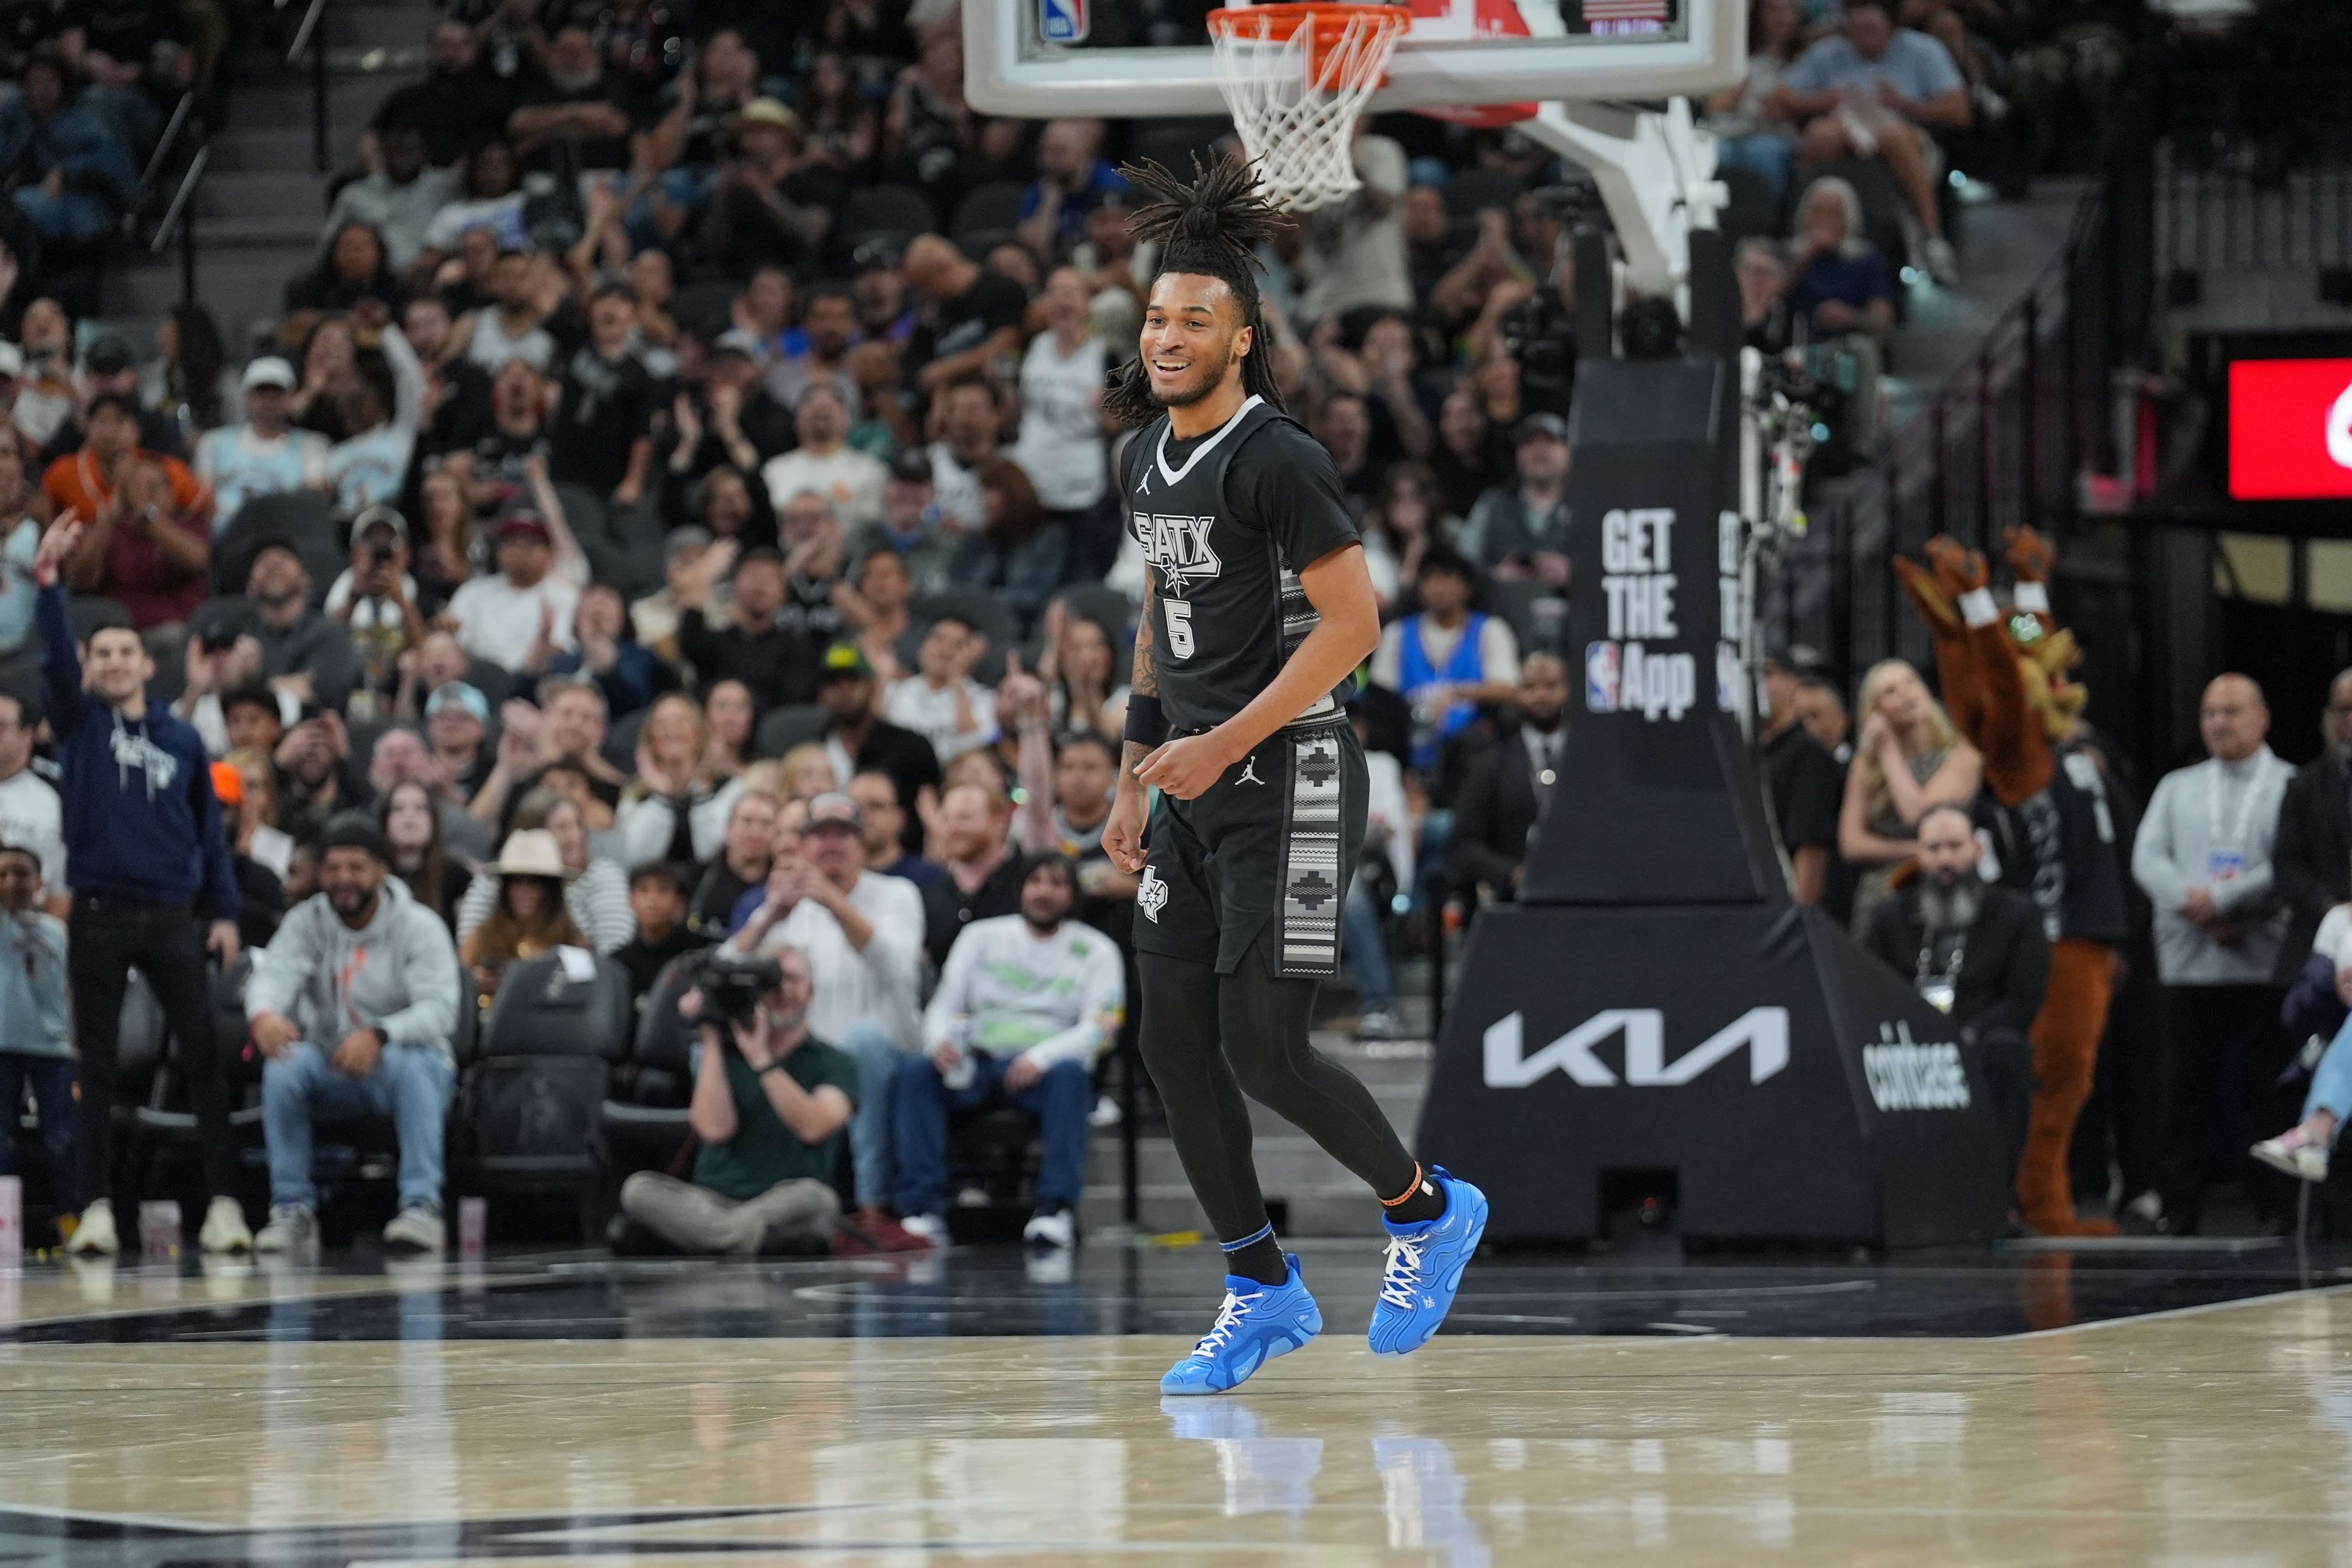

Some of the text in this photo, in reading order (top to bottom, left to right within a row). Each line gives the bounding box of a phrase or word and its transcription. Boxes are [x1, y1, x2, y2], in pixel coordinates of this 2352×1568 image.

[1134, 511, 1222, 578] SATX
[1601, 508, 1677, 574] GET
[1163, 598, 1195, 660] 5
[1601, 572, 1679, 640] THE
[1620, 641, 1696, 722] App
